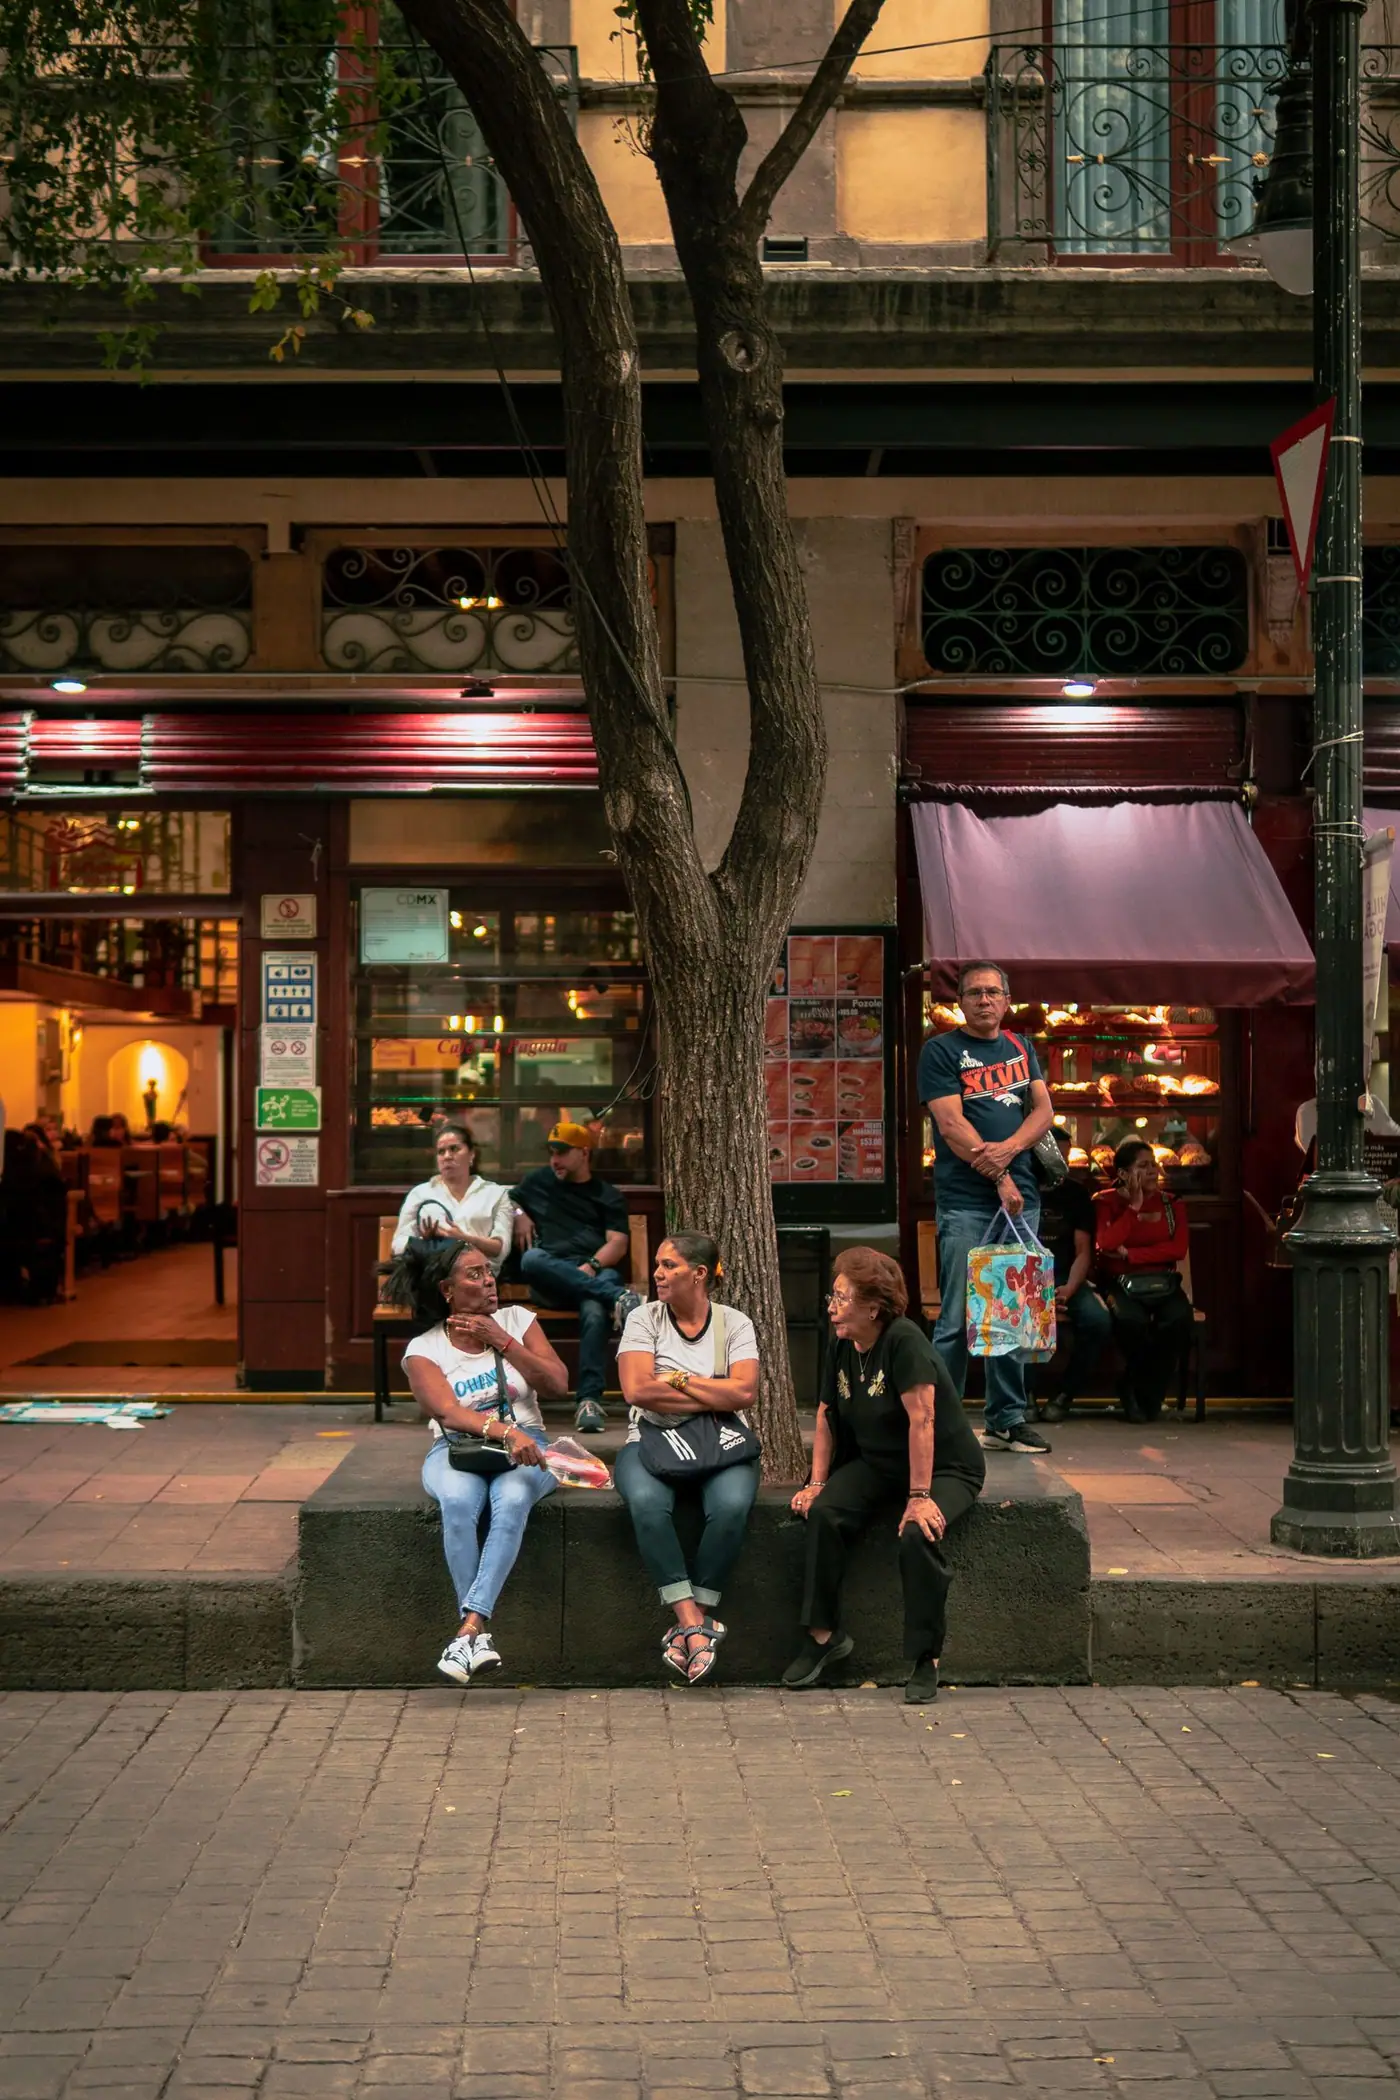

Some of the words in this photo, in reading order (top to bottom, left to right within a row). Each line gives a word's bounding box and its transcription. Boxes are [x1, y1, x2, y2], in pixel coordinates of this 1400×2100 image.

[397, 894, 436, 905] CDMX
[852, 999, 882, 1008] Pozole
[437, 1039, 473, 1055] Café
[506, 1039, 568, 1057] Pagoda
[455, 1367, 504, 1397] OHAN
[722, 1435, 746, 1451] adidas
